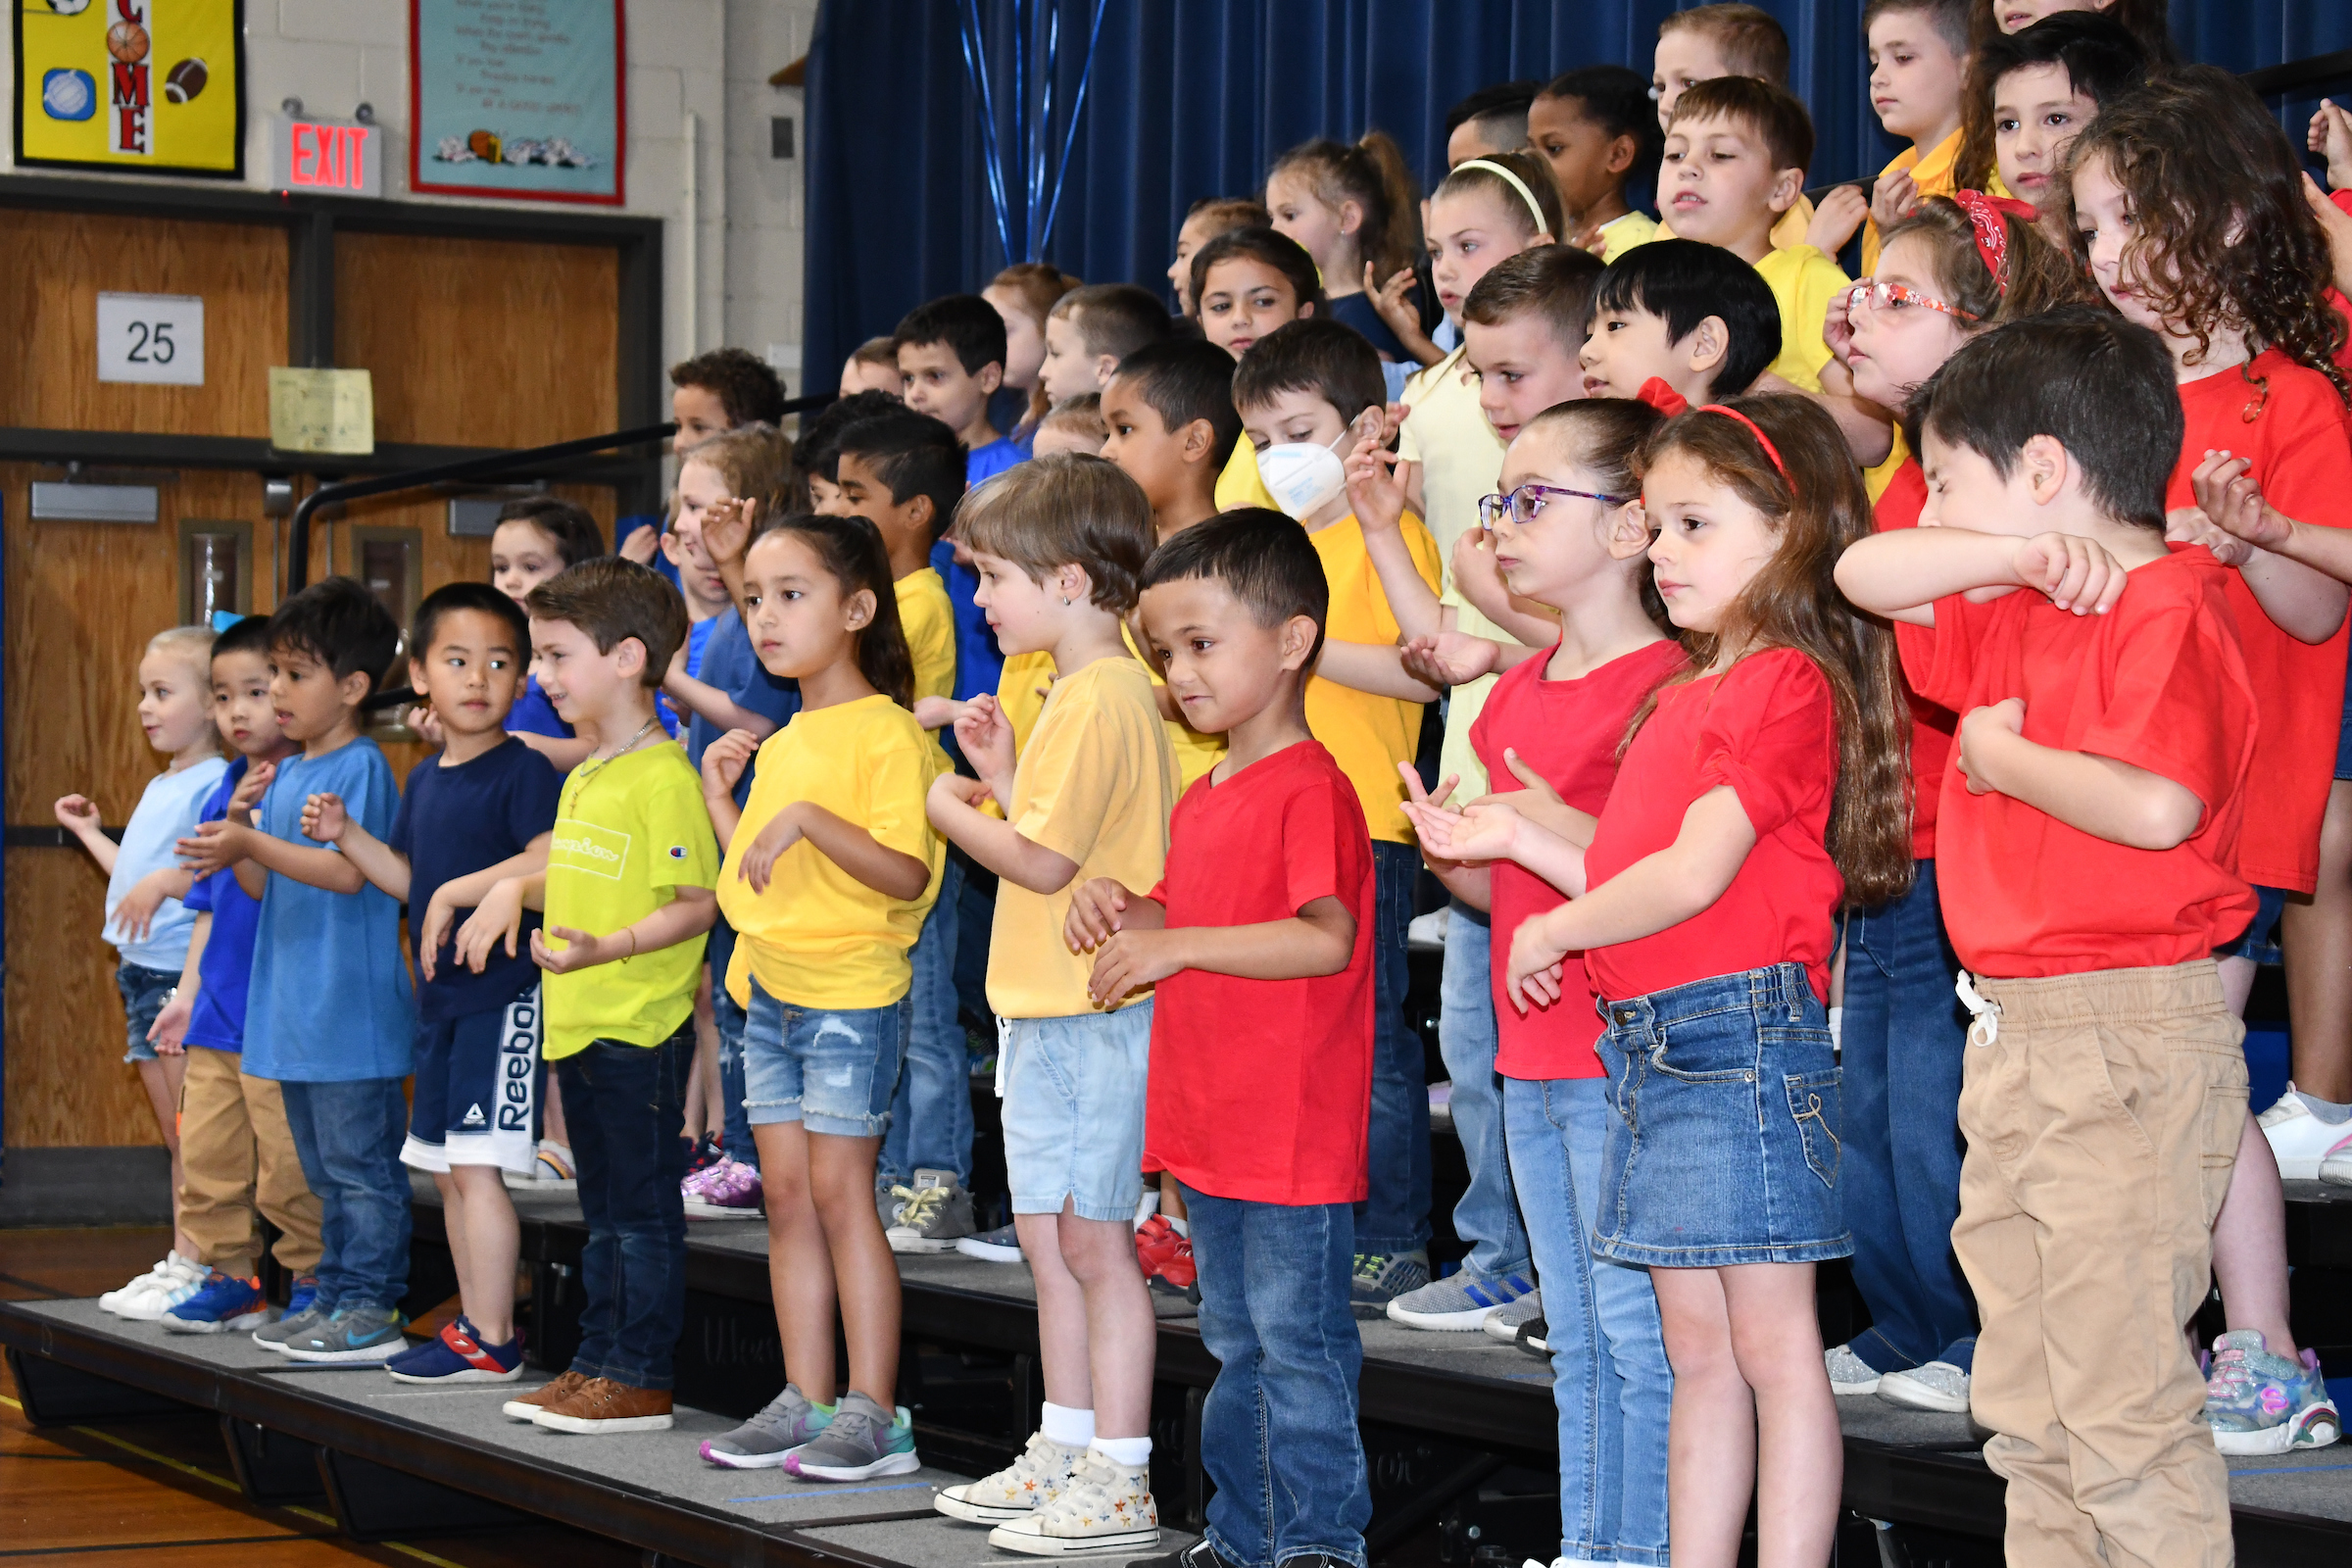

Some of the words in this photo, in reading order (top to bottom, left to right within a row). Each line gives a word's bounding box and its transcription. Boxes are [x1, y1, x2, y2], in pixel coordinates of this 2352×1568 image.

[291, 122, 368, 189] EXIT
[127, 320, 174, 365] 25
[552, 832, 619, 861] mpion
